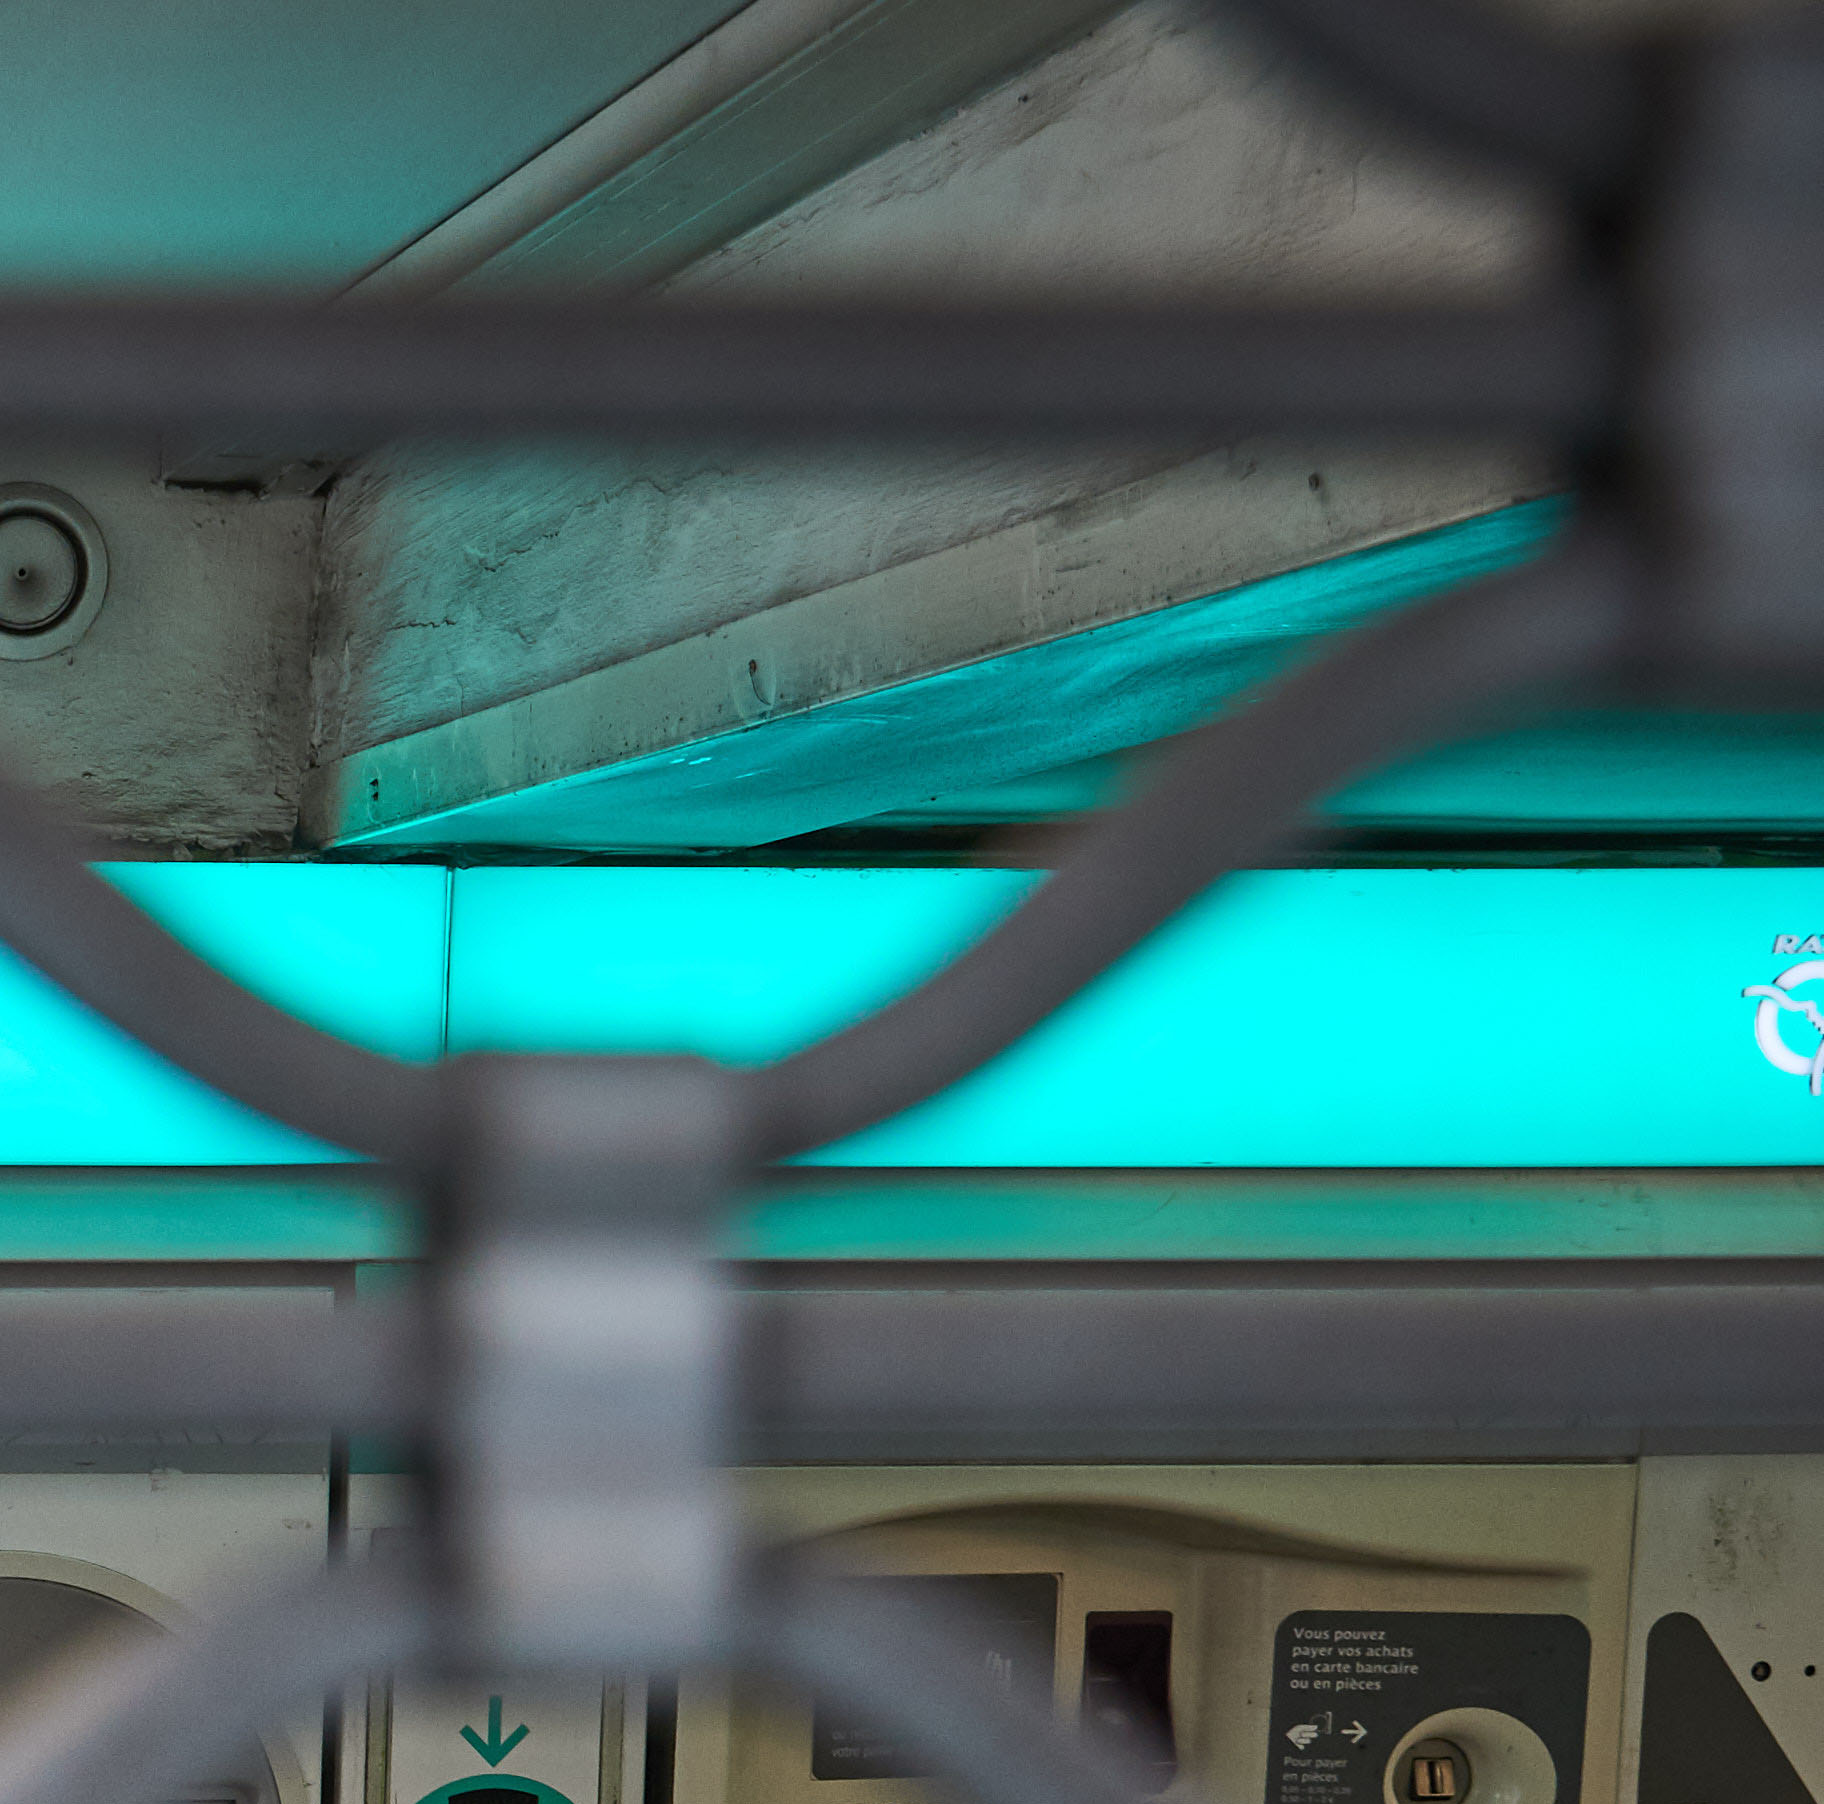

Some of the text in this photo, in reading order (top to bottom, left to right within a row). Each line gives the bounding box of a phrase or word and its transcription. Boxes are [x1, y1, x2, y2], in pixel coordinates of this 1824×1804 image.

[1772, 933, 1824, 954] RA
[1293, 1628, 1386, 1642] Vous pouvez
[1291, 1645, 1414, 1658] payer vos achats
[1290, 1661, 1419, 1675] en carte bancaire
[1289, 1677, 1382, 1692] ou en pièces
[1283, 1756, 1347, 1770] Pour payer
[1282, 1773, 1298, 1781] en
